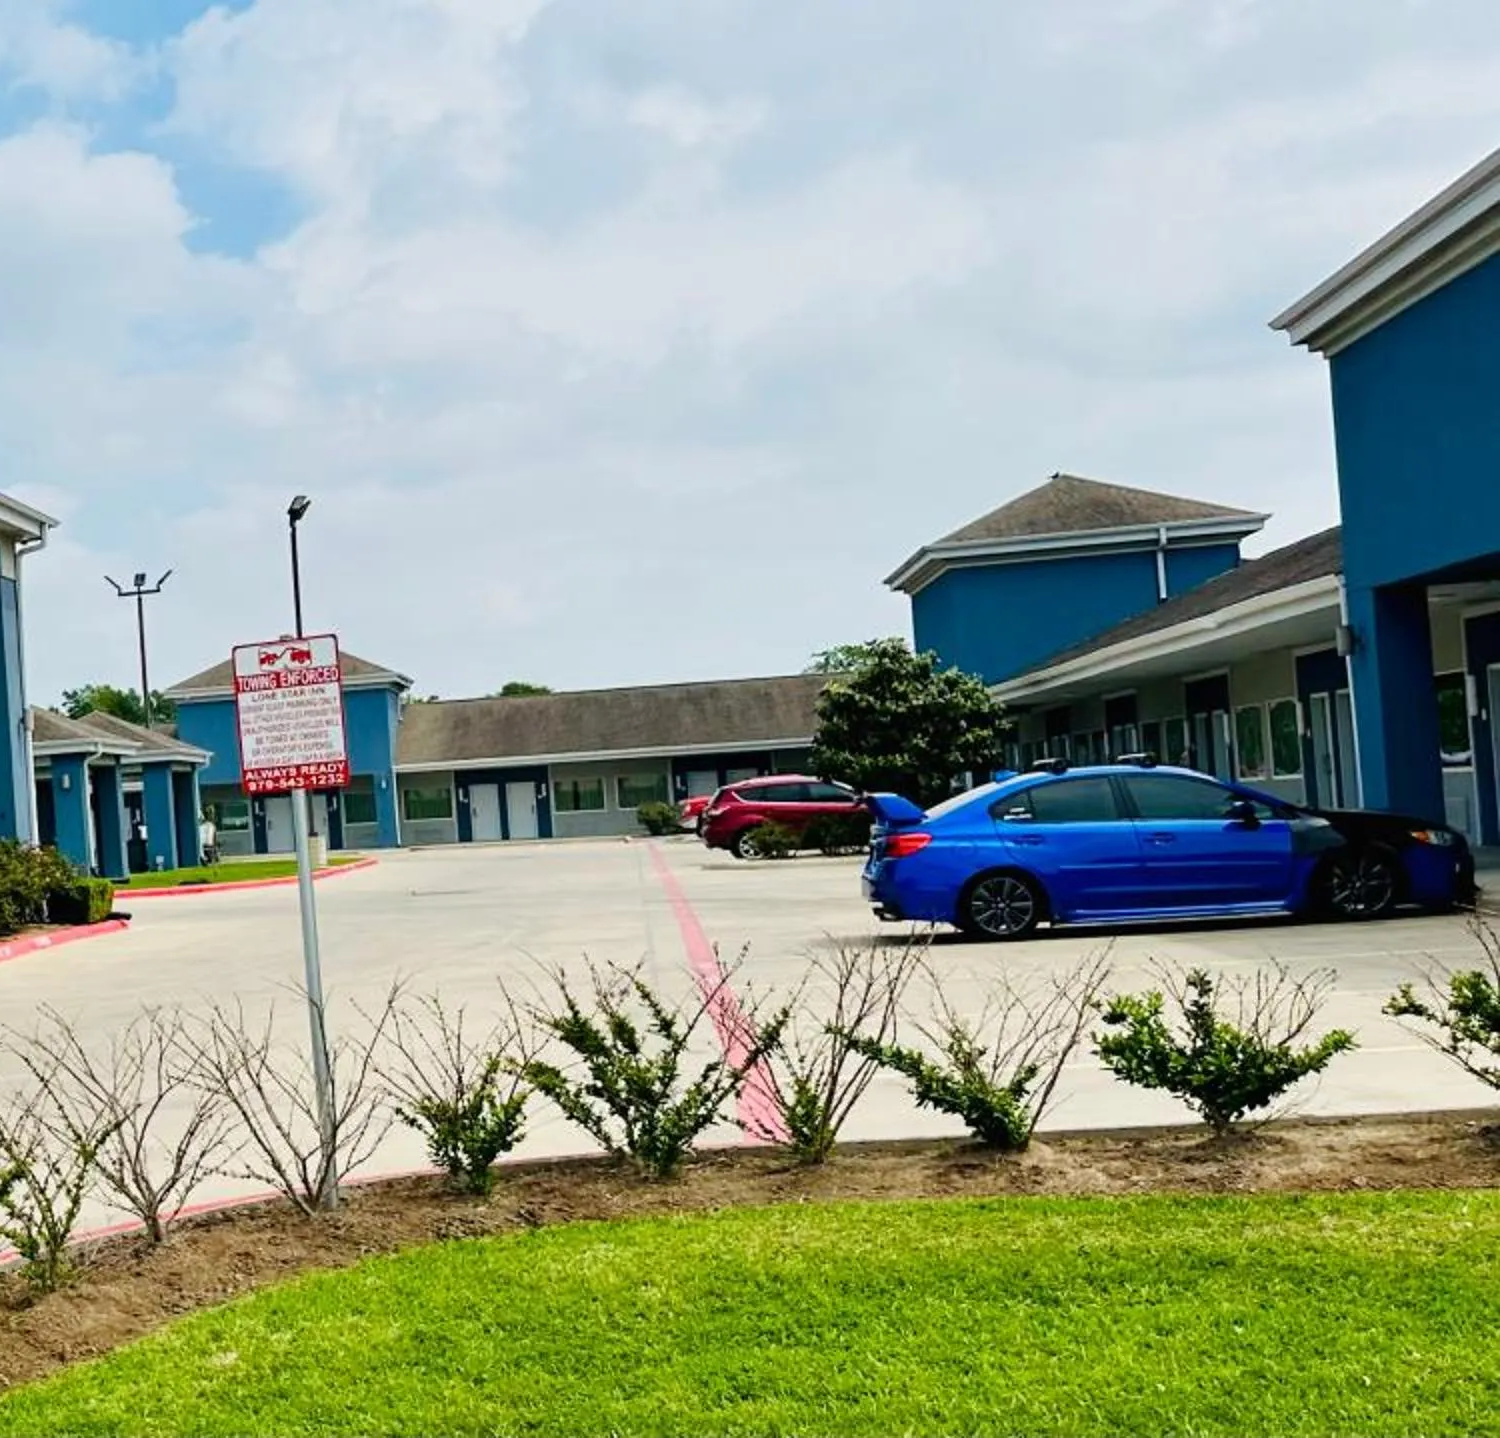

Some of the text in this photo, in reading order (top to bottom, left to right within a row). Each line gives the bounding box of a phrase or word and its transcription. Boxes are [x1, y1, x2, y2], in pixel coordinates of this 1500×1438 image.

[238, 667, 339, 691] TOWING ENFORCED
[251, 691, 276, 702] LONE
[281, 688, 306, 698] STAR
[245, 761, 345, 781] ALWAYS READY
[247, 773, 345, 791] 979-543-1232
